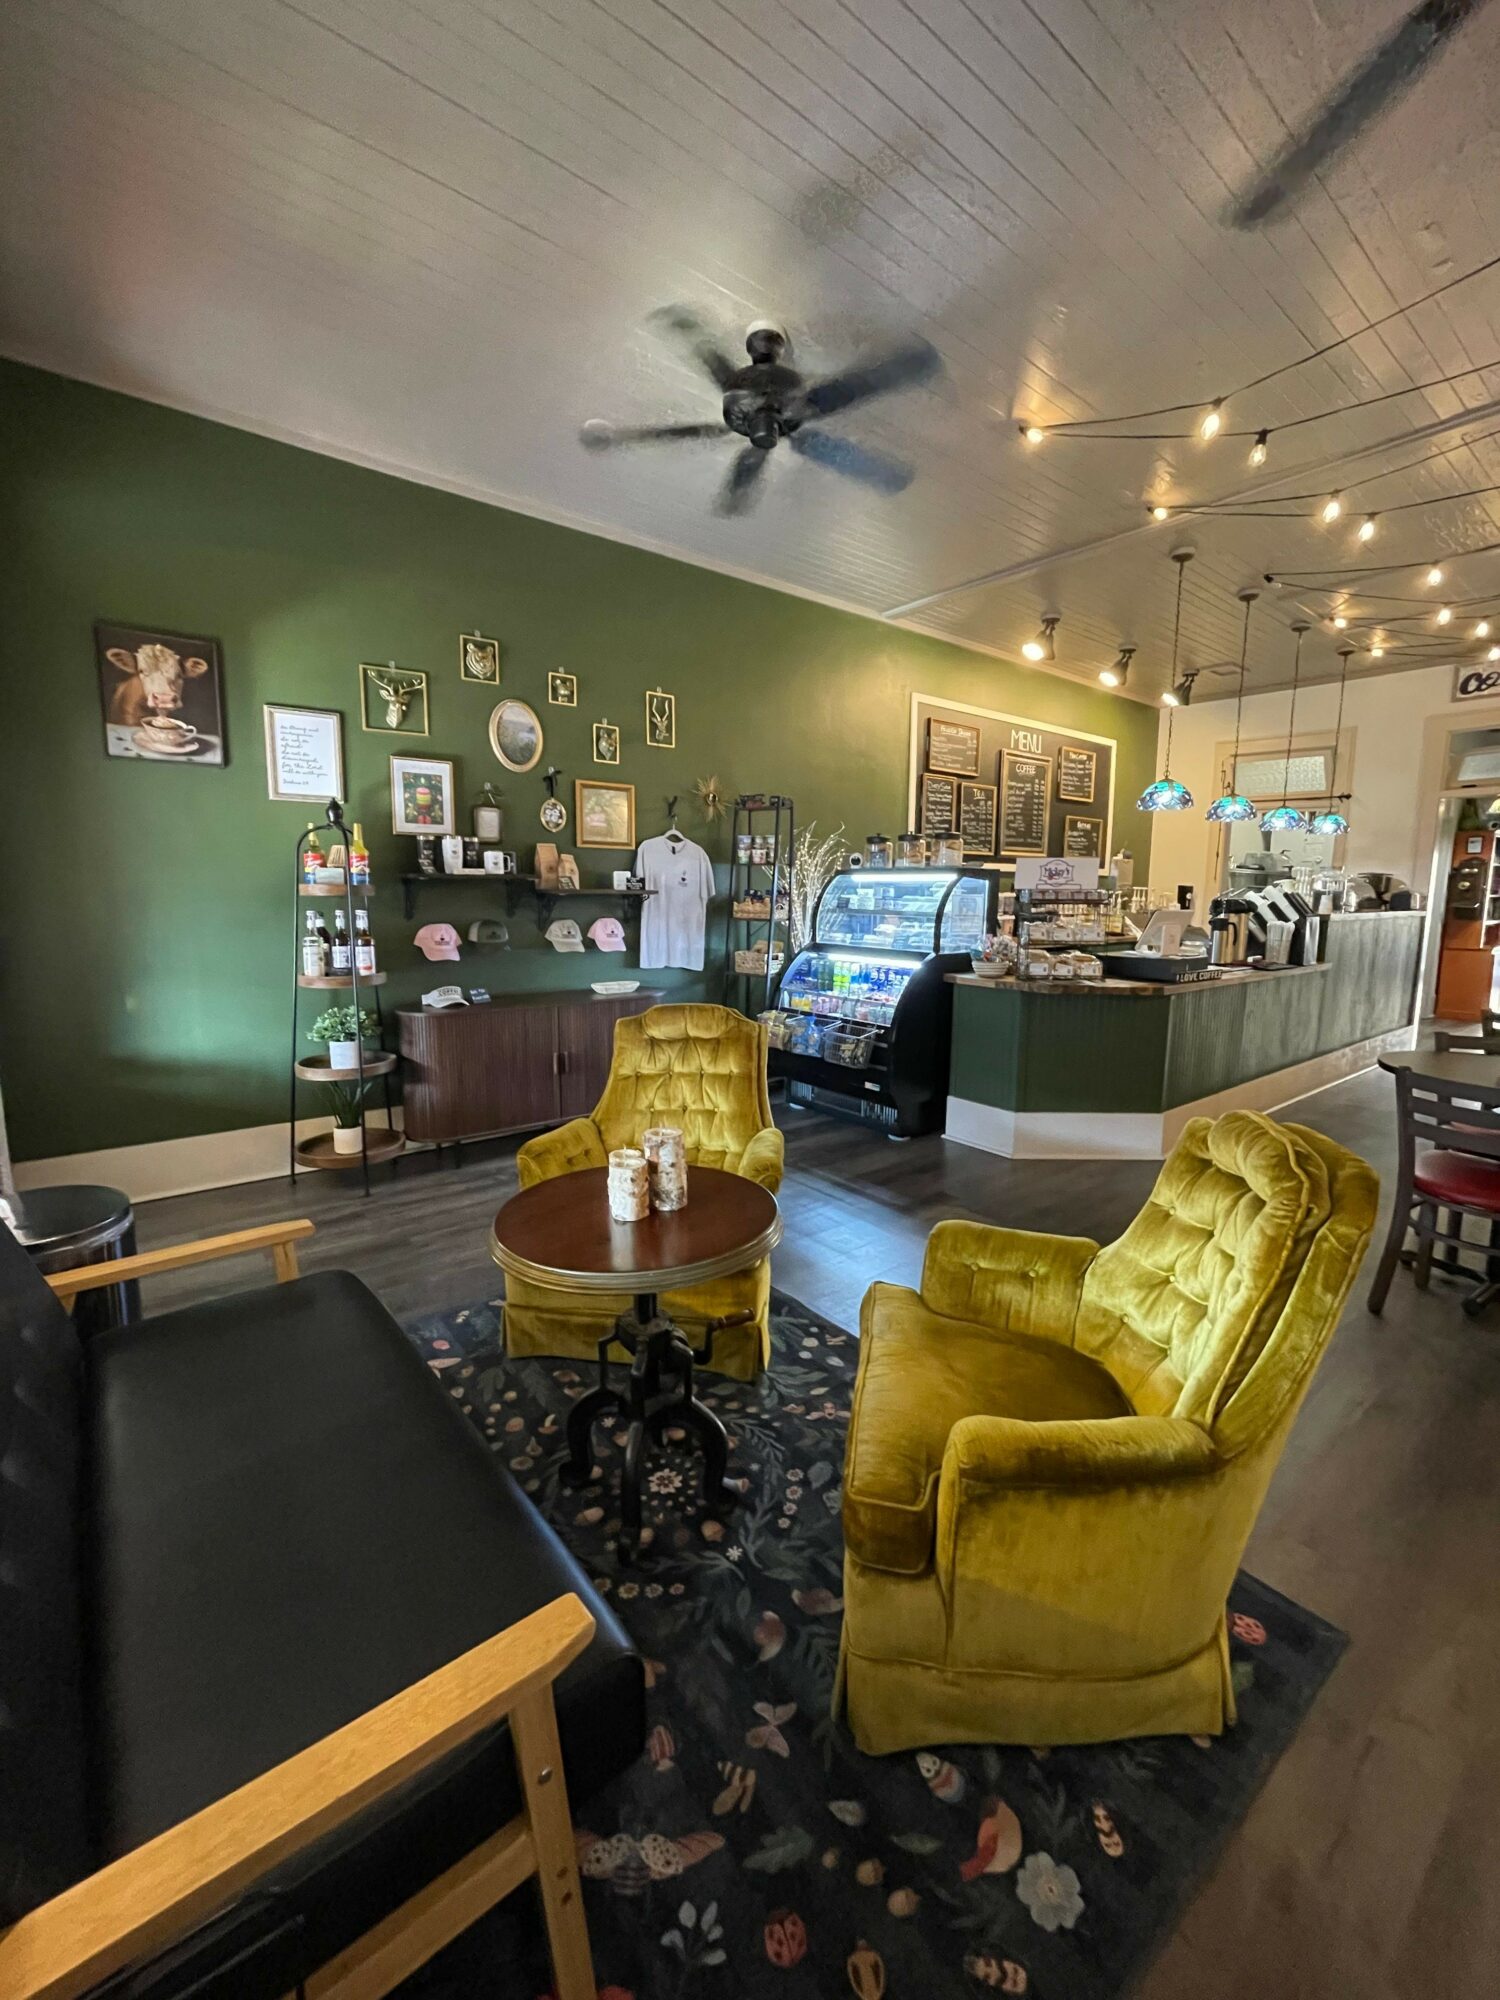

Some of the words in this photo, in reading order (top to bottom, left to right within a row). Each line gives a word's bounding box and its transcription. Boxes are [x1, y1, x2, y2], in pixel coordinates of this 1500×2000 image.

[1011, 729, 1042, 754] MENU
[1015, 763, 1037, 775] COFFEE
[973, 788, 985, 797] TEA
[1180, 972, 1198, 982] LOVE
[1199, 971, 1222, 980] COFFEE
